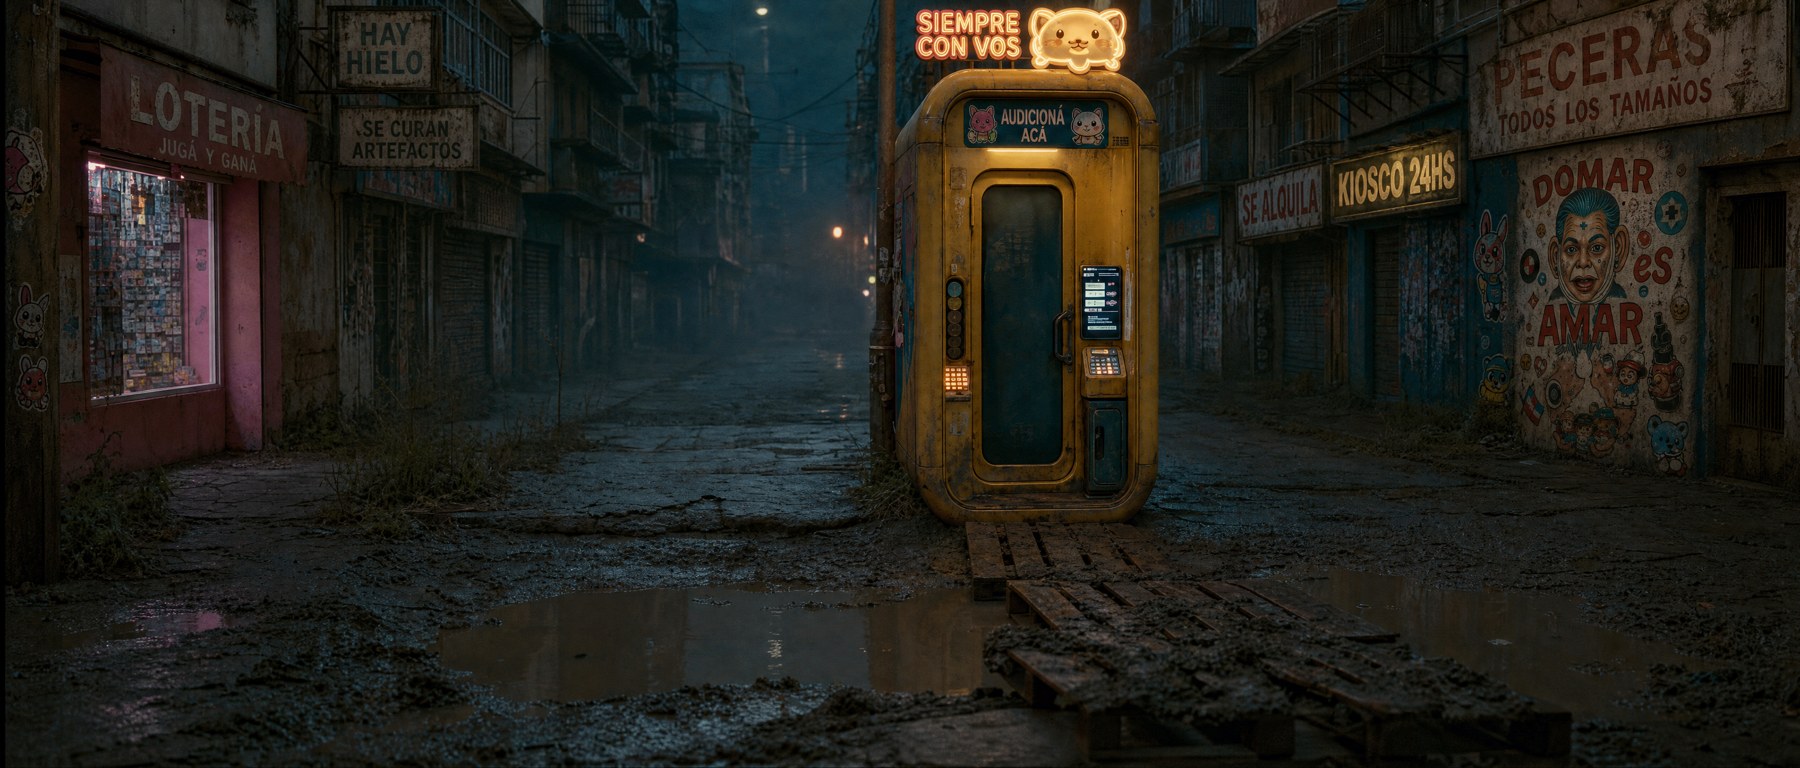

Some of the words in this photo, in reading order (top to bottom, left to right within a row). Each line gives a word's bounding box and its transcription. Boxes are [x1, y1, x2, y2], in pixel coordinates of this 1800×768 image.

[360, 22, 411, 46] HAY
[916, 10, 1020, 35] SIEMPRE
[347, 50, 423, 74] HIELO
[915, 35, 968, 60] CON
[972, 35, 1021, 60] VOS
[1494, 16, 1711, 106] PECERAS
[129, 74, 285, 160] LOTERÍA
[1001, 104, 1066, 126] AUDICIONÁ
[1499, 105, 1555, 136] TODOS
[1566, 97, 1600, 124] LOS
[1610, 76, 1713, 117] TAMAÑOS
[363, 120, 384, 137] SE
[391, 120, 449, 137] CURAN
[1021, 126, 1048, 143] ACÁ
[159, 137, 198, 161] JUGÁ
[206, 148, 215, 165] Y
[221, 153, 257, 174] GANÁ
[352, 142, 462, 159] ARTEFACTOS
[1338, 160, 1405, 207] KIOSCO
[1409, 149, 1456, 195] 24HS
[1533, 158, 1654, 208] DOMAR
[1242, 192, 1258, 225] SE
[1262, 179, 1319, 223] ALQUILA
[1537, 302, 1643, 347] AMAR
